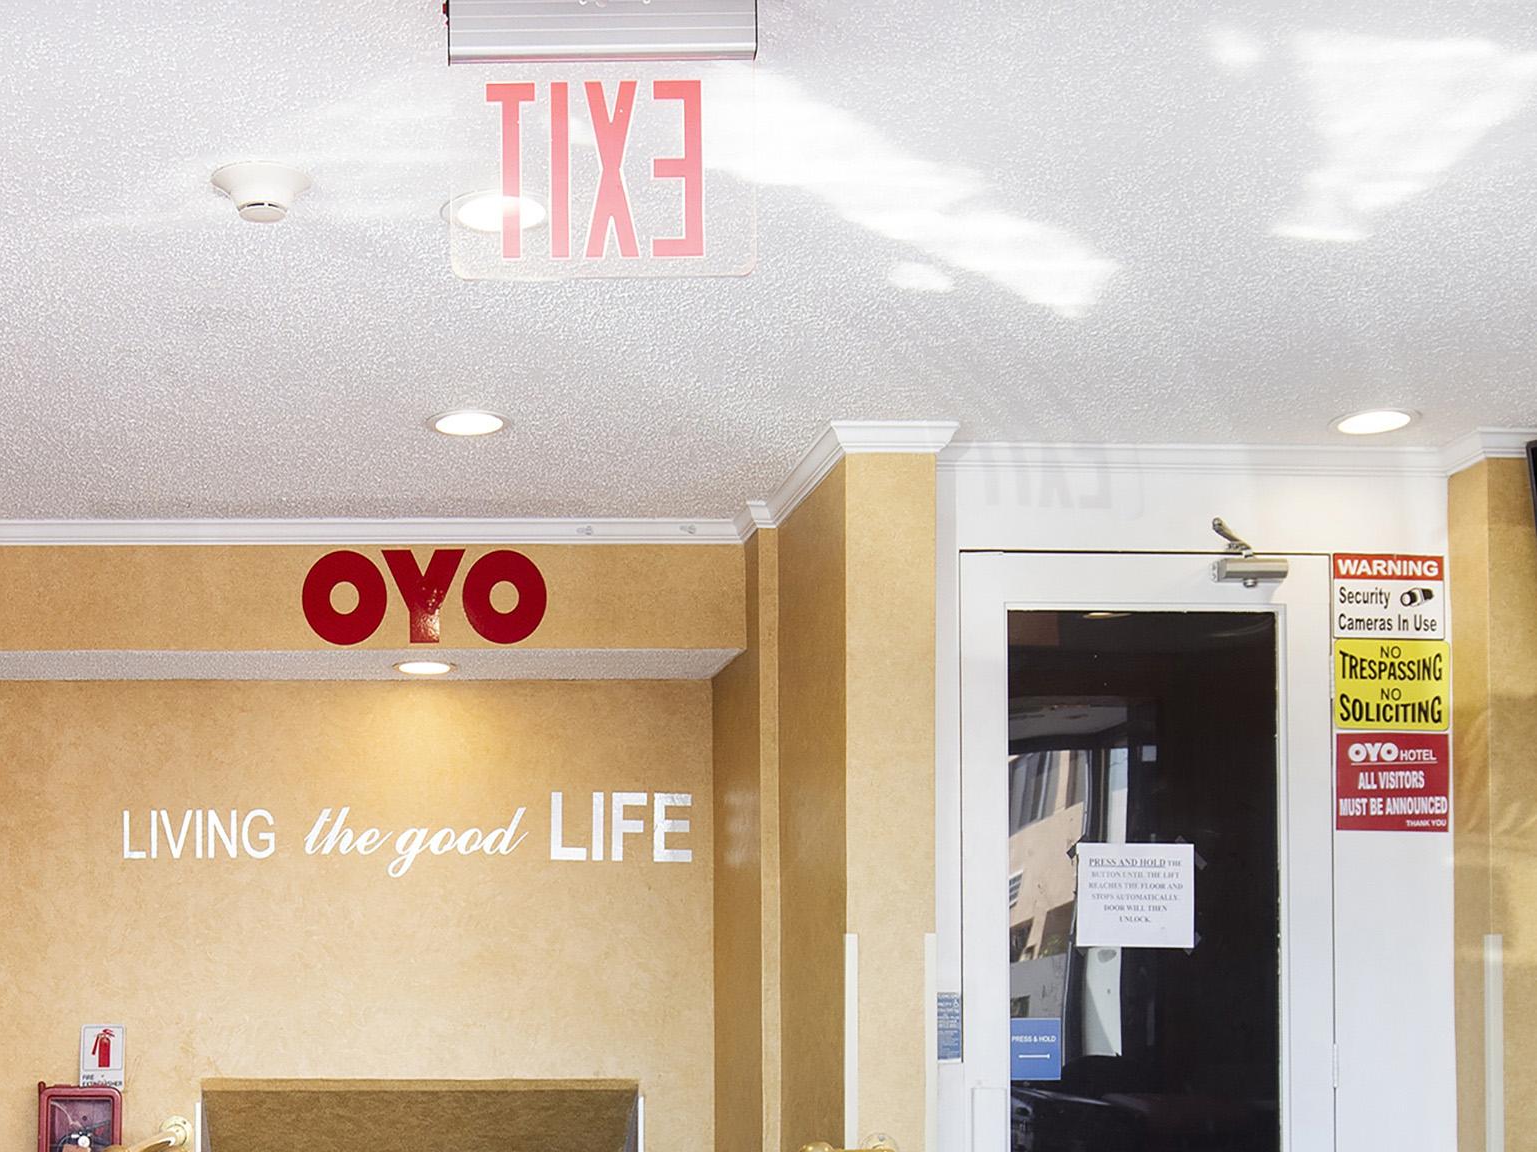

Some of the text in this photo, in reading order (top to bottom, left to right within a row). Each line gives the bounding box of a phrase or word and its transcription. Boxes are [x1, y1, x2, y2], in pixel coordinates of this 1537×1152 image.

[1337, 559, 1439, 577] WARNING
[301, 549, 548, 646] OYO
[1339, 586, 1391, 609] Security
[1338, 613, 1437, 632] Cameras In Use
[1380, 646, 1401, 659] NO
[1339, 650, 1443, 681] TRESPASSING
[1380, 688, 1401, 700] NO
[1339, 693, 1443, 724] SOLICITING
[1348, 742, 1438, 762] OYO HOTEL
[1357, 770, 1426, 790] ALL VISITORS
[1339, 796, 1448, 816] MUST BE ANNOUNCED
[1405, 819, 1447, 827] THANK YOU
[123, 791, 693, 878] LIVING the good LIFE
[1088, 858, 1117, 868] PRESS
[1119, 858, 1138, 868] AND
[1140, 858, 1166, 868] HOLD
[1091, 871, 1180, 879] BUTTON UNTIL THE LIFT
[1088, 882, 1184, 890] REACHES THE FLOOR AND
[1091, 893, 1115, 901] STOPS
[1103, 904, 1168, 912] DOOR WILL THEN
[1011, 1035, 1033, 1043] PRESS
[1039, 1035, 1057, 1043] HOLD
